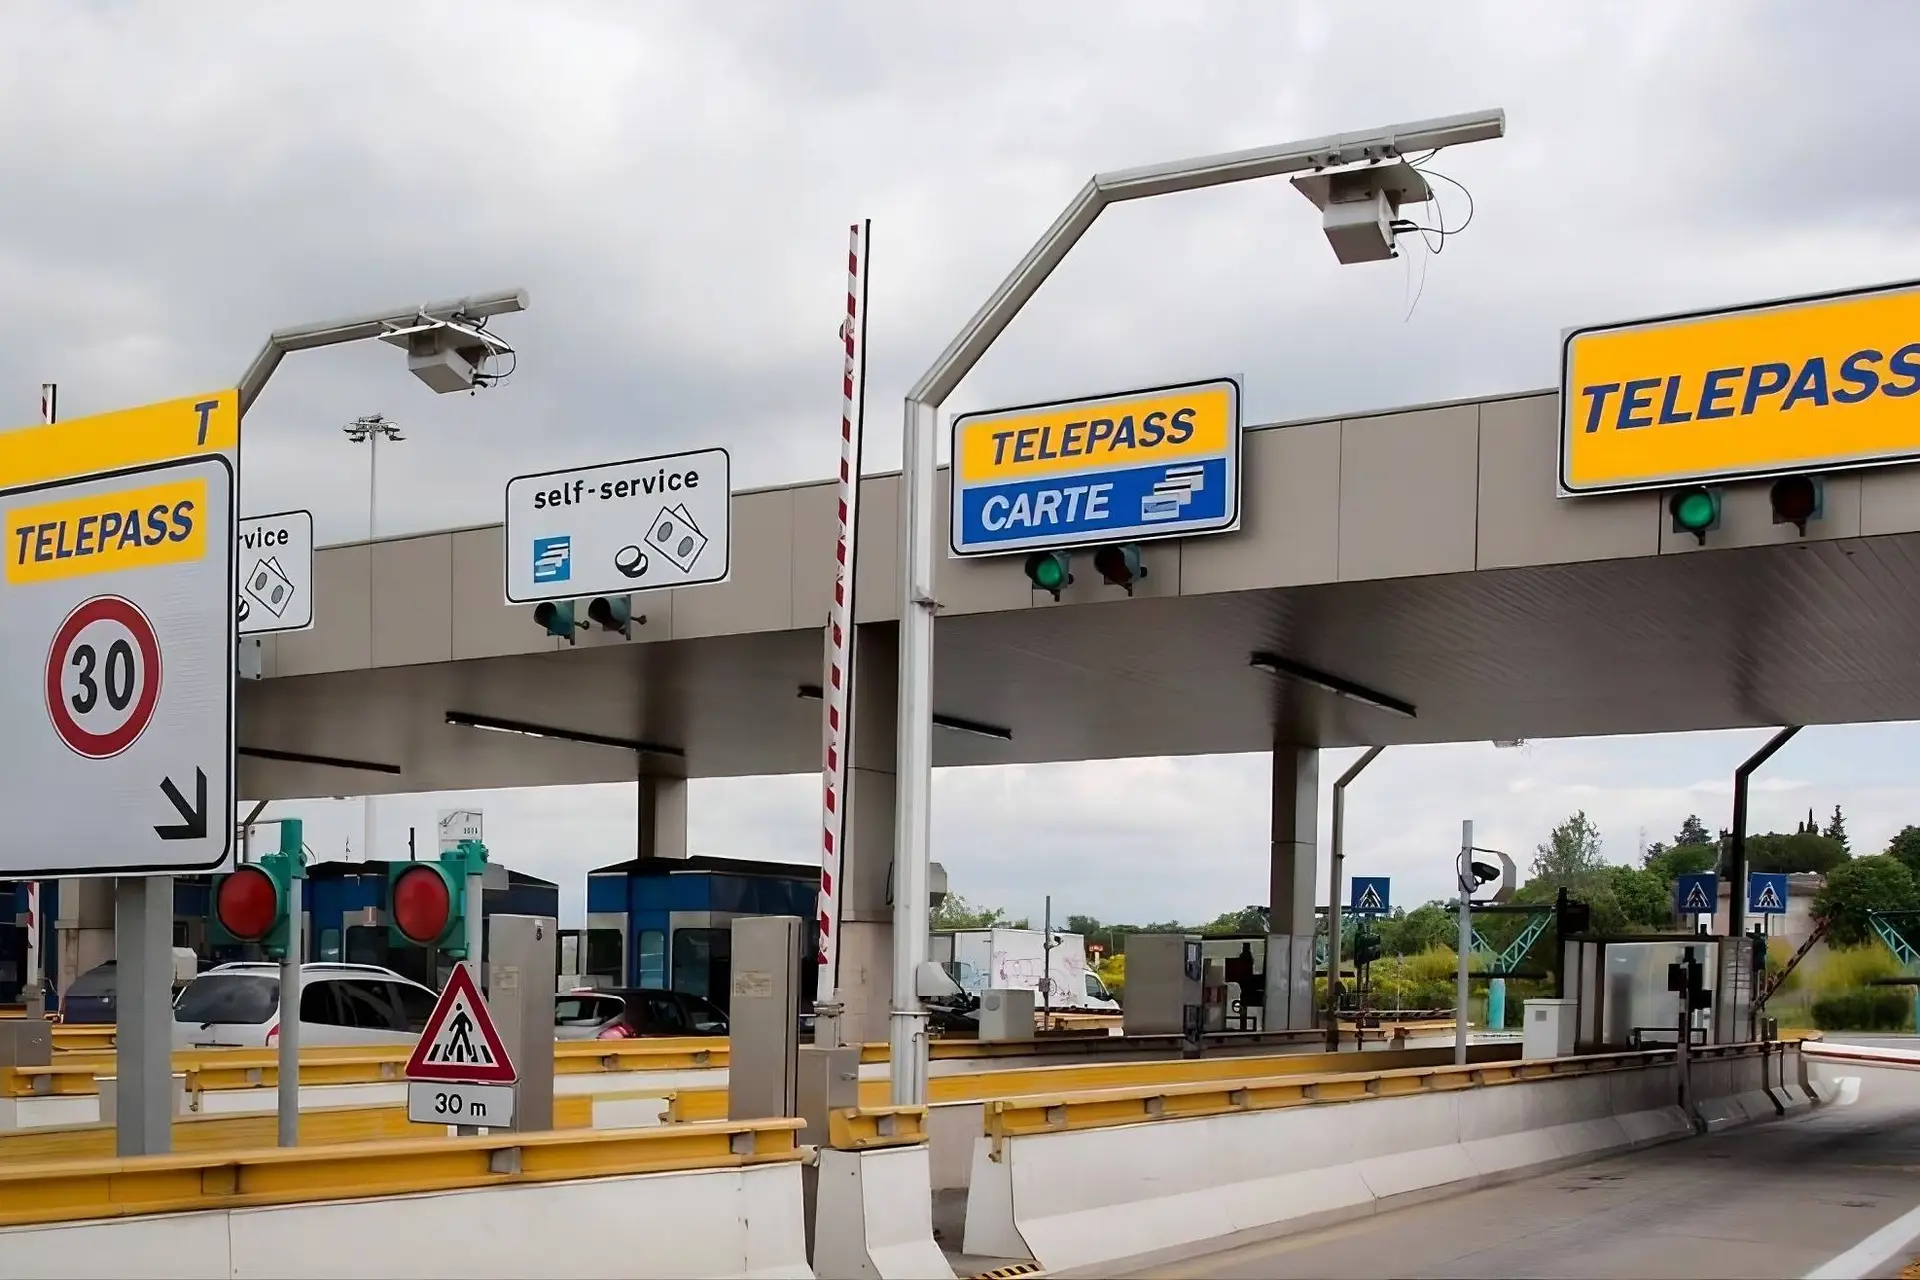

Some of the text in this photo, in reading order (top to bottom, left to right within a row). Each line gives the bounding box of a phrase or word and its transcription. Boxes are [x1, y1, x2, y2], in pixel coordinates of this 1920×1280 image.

[1582, 343, 1920, 434] TELEPASS
[194, 400, 219, 446] T
[991, 408, 1196, 465] TELEPASS
[534, 469, 699, 509] self-service
[981, 483, 1113, 531] CARTE
[16, 500, 194, 564] TELEPASS
[238, 526, 289, 549] vice
[71, 638, 135, 713] 30
[435, 1092, 487, 1116] 30 m
